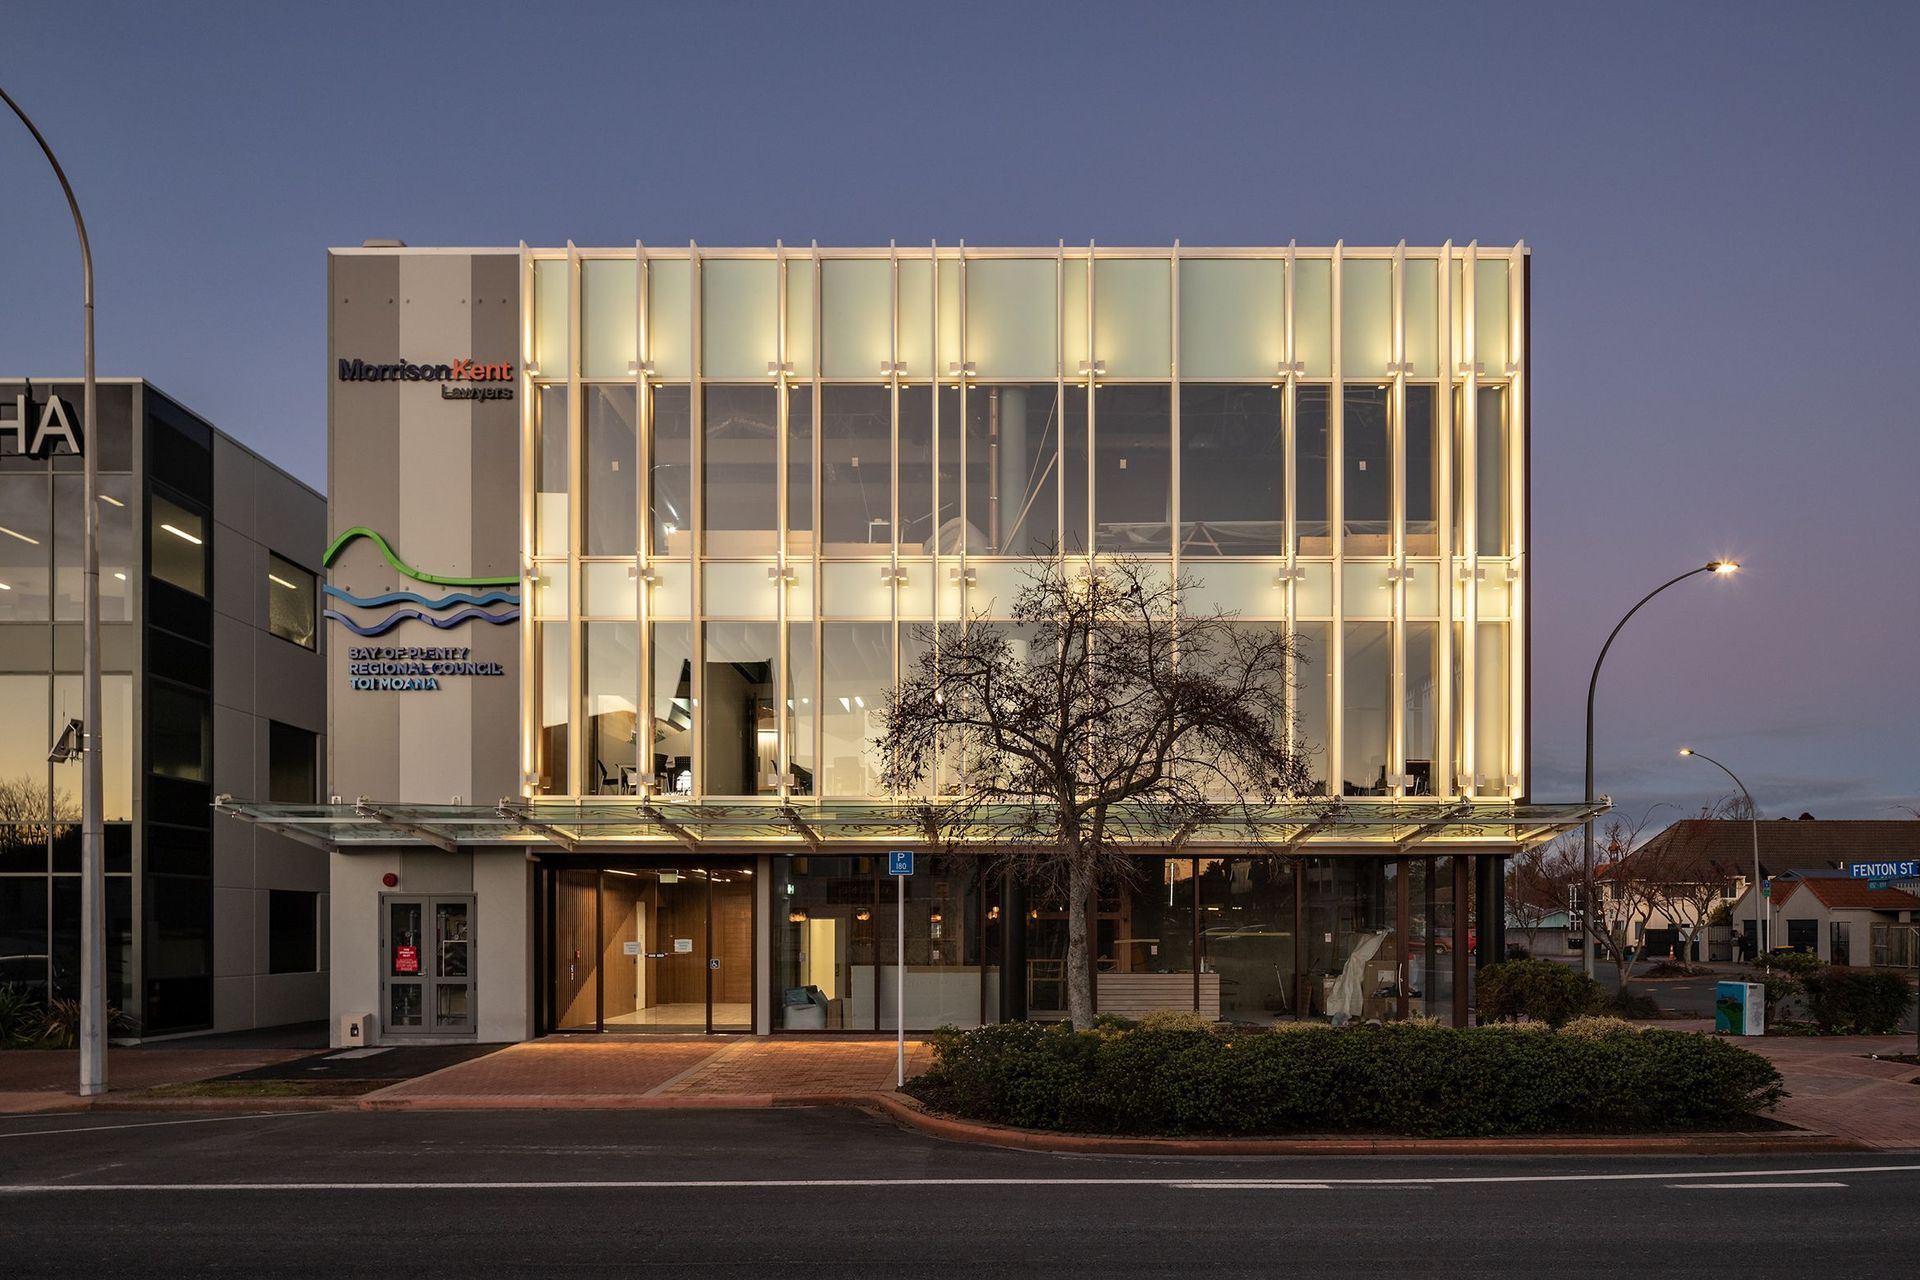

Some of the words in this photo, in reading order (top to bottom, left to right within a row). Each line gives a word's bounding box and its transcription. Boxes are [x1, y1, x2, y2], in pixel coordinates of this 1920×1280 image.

[441, 384, 513, 402] Lawyers
[350, 647, 382, 659] BAY
[383, 647, 404, 659] OF
[408, 647, 468, 660] PLENTY
[350, 662, 427, 675] REGIONAL
[432, 662, 503, 675] COUNCIL
[350, 678, 374, 690] TOI
[379, 678, 438, 690] MOANA
[897, 853, 905, 861] P
[1853, 863, 1897, 877] FENTON
[1900, 862, 1914, 875] ST
